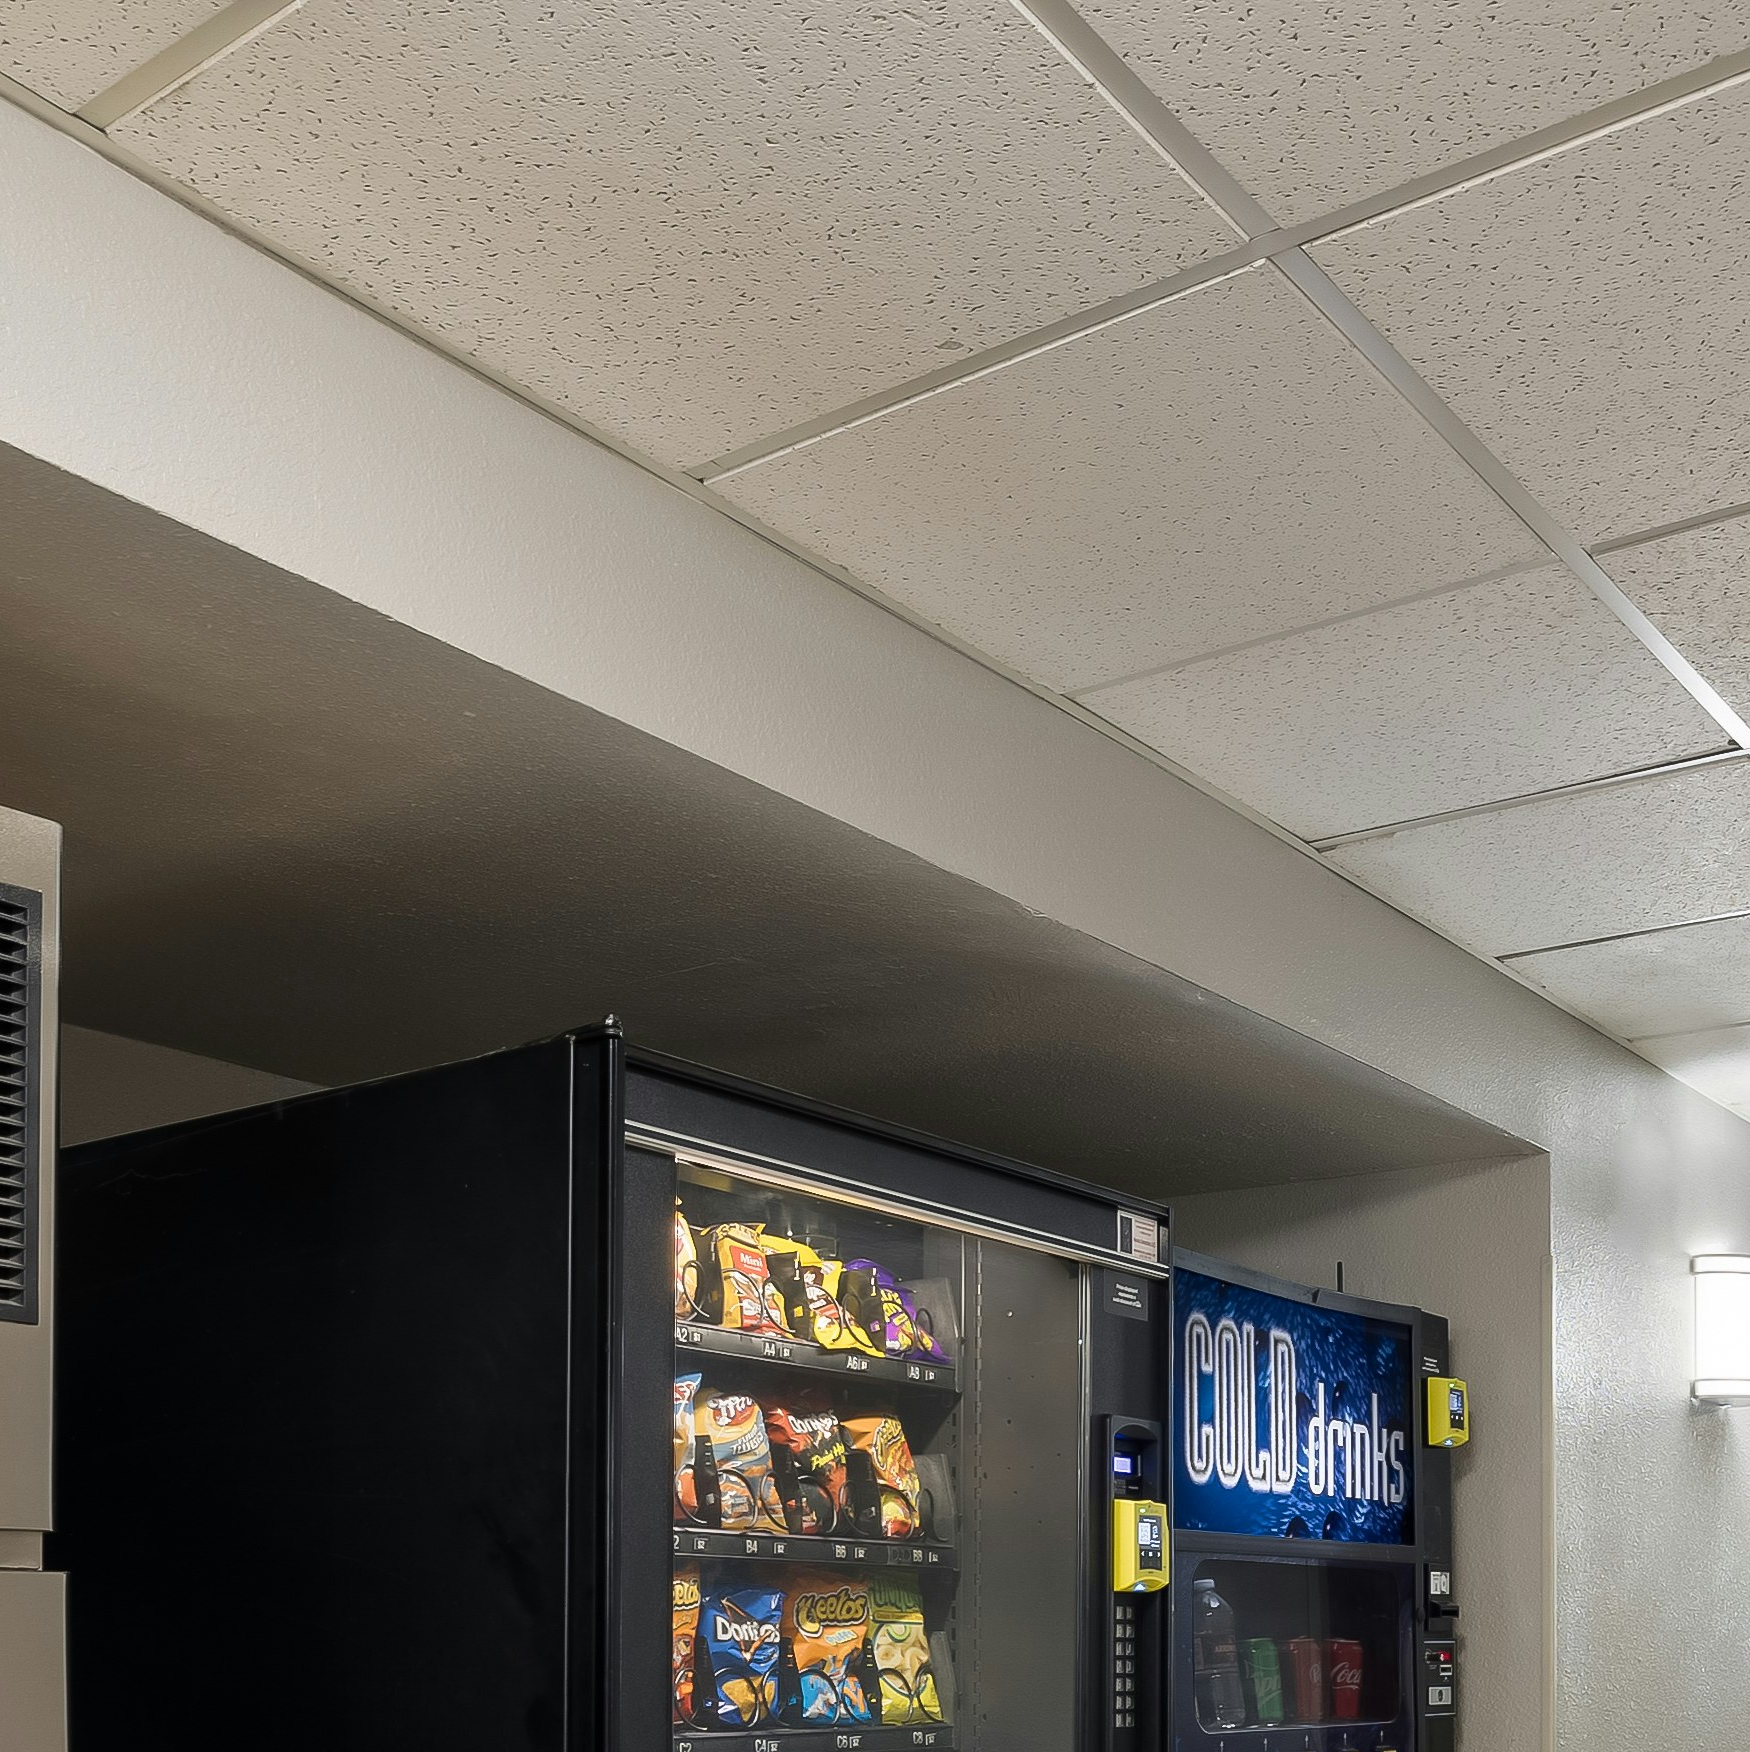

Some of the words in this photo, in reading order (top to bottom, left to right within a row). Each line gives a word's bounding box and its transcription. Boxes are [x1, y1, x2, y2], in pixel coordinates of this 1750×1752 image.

[739, 1252, 764, 1269] Mini
[763, 1341, 776, 1357] A4
[1185, 1311, 1297, 1495] COLD
[1308, 1380, 1405, 1506] drinks
[746, 1540, 758, 1554] B4
[715, 1616, 780, 1643] Doritos
[755, 1739, 766, 1752] C4
